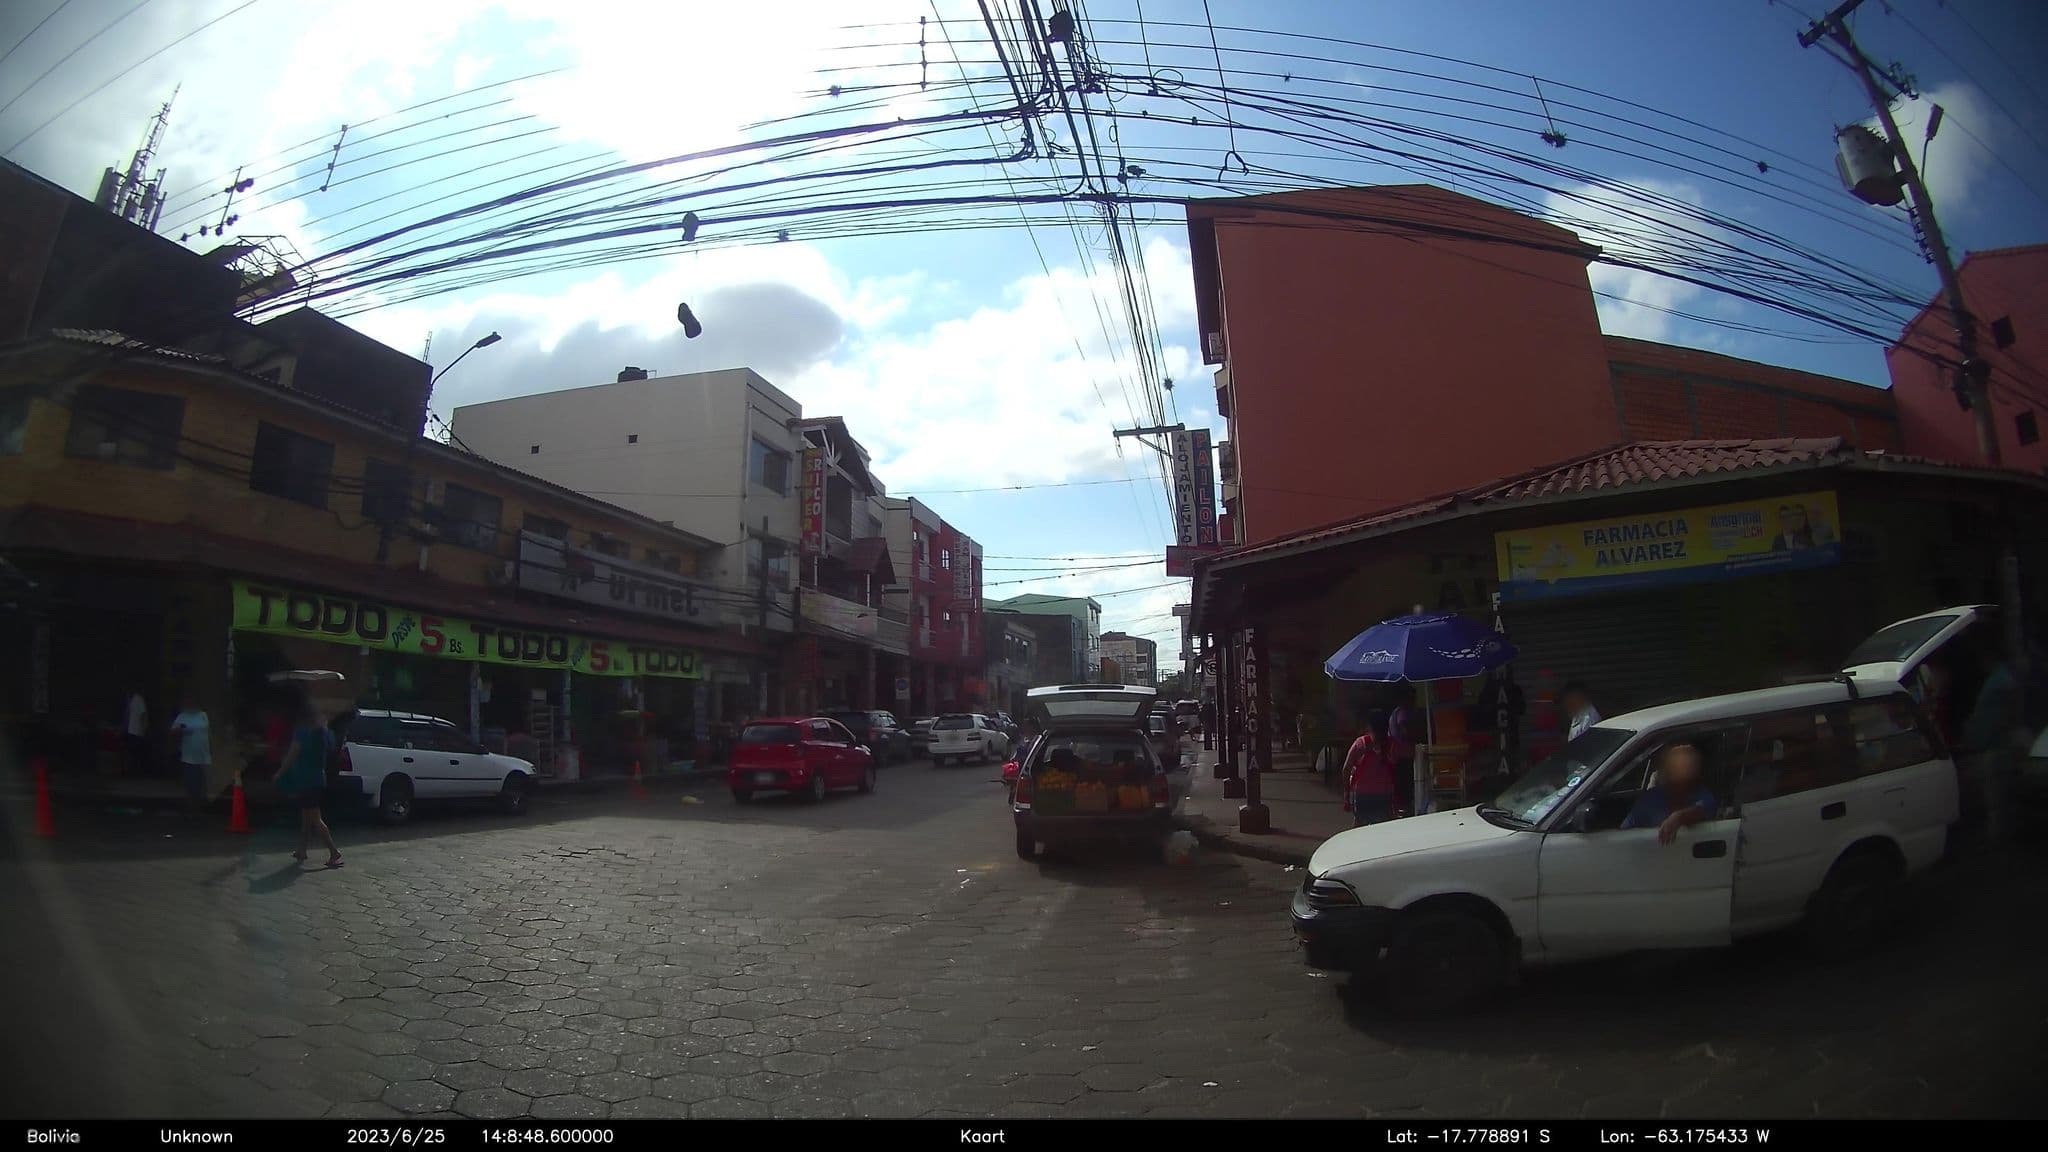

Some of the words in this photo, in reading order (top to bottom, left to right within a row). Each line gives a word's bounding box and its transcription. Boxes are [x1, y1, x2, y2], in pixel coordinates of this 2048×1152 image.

[1177, 433, 1193, 544] ALOJAMIENTO
[1195, 431, 1214, 544] PAILON
[1583, 518, 1689, 547] FARMACIA
[1595, 541, 1688, 568] ALVAREZ
[248, 588, 388, 641] TODO
[420, 614, 445, 652] 5
[470, 623, 568, 664] TODO
[590, 642, 609, 671] 5
[627, 646, 693, 674] TODO
[1491, 591, 1510, 776] FAMACIA
[1245, 627, 1260, 771] FARMACIA
